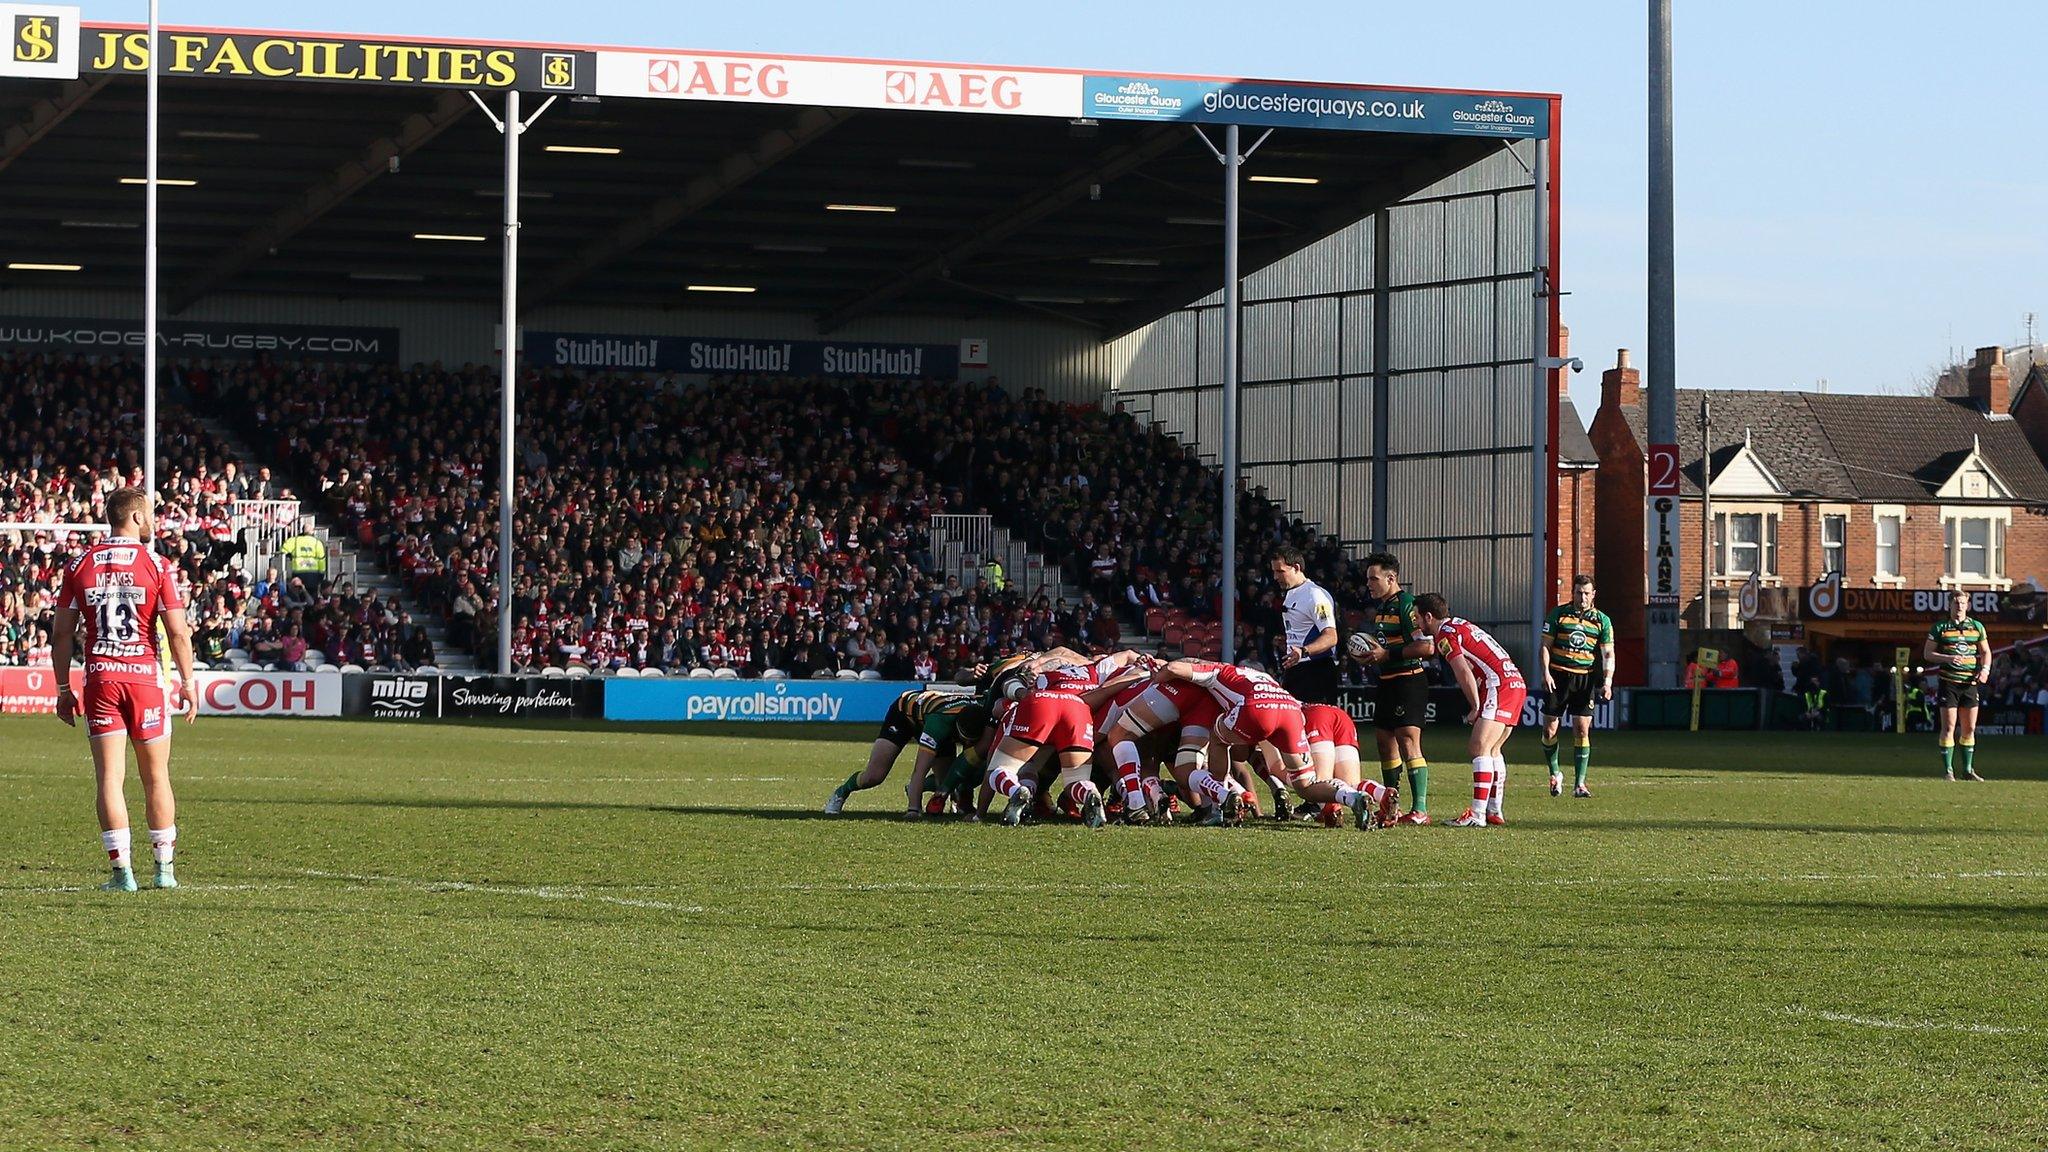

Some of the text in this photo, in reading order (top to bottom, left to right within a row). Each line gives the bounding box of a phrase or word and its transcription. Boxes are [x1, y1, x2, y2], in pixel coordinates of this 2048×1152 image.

[93, 33, 517, 87] JS FACILITIES
[684, 61, 789, 98] AEG
[920, 73, 1022, 109] AEG
[1095, 93, 1181, 108] Gloucester Quays
[1203, 90, 1426, 120] gloucesterquays.co.uk
[1453, 110, 1534, 125] Gloucester Quays
[555, 337, 658, 368] StubHub!
[690, 342, 791, 372] StubHub!
[823, 346, 922, 376] StubHub!
[968, 344, 980, 359] F
[1652, 452, 1676, 489] 2
[96, 571, 134, 588] MEAKES
[1650, 596, 1679, 604] Miele
[100, 603, 134, 641] 13
[90, 661, 152, 674] DOWNTON
[372, 677, 429, 699] mira
[452, 688, 512, 714] Showering
[374, 709, 422, 719] SHOWERS
[687, 690, 843, 720] payrollsimply
